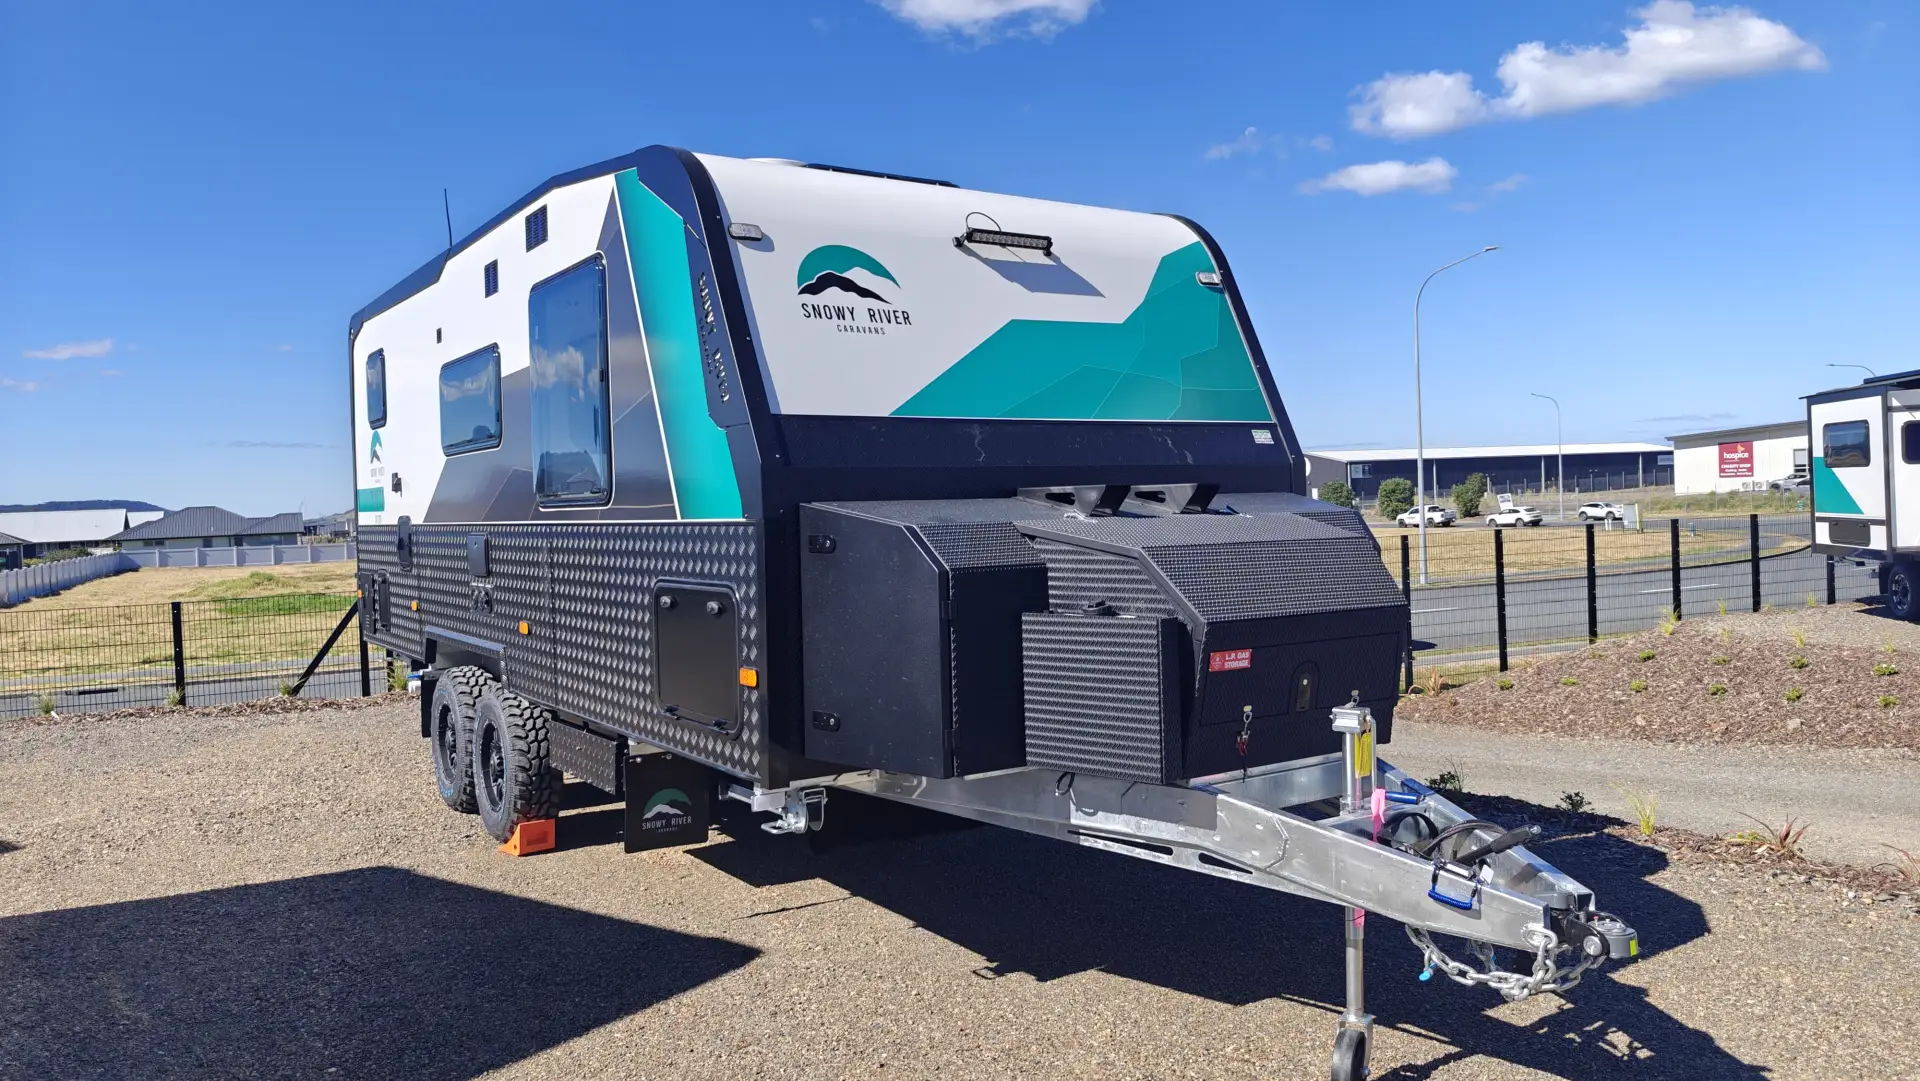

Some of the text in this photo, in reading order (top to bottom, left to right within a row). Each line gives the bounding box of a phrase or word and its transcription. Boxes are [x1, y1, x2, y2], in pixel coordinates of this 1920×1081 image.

[801, 303, 912, 325] SNOWY RIVER
[836, 324, 886, 335] CARAVANS
[1723, 451, 1749, 460] hospice
[1237, 651, 1250, 659] GAS
[1224, 659, 1249, 669] STORAGE
[642, 816, 692, 830] SNOWY RIVER
